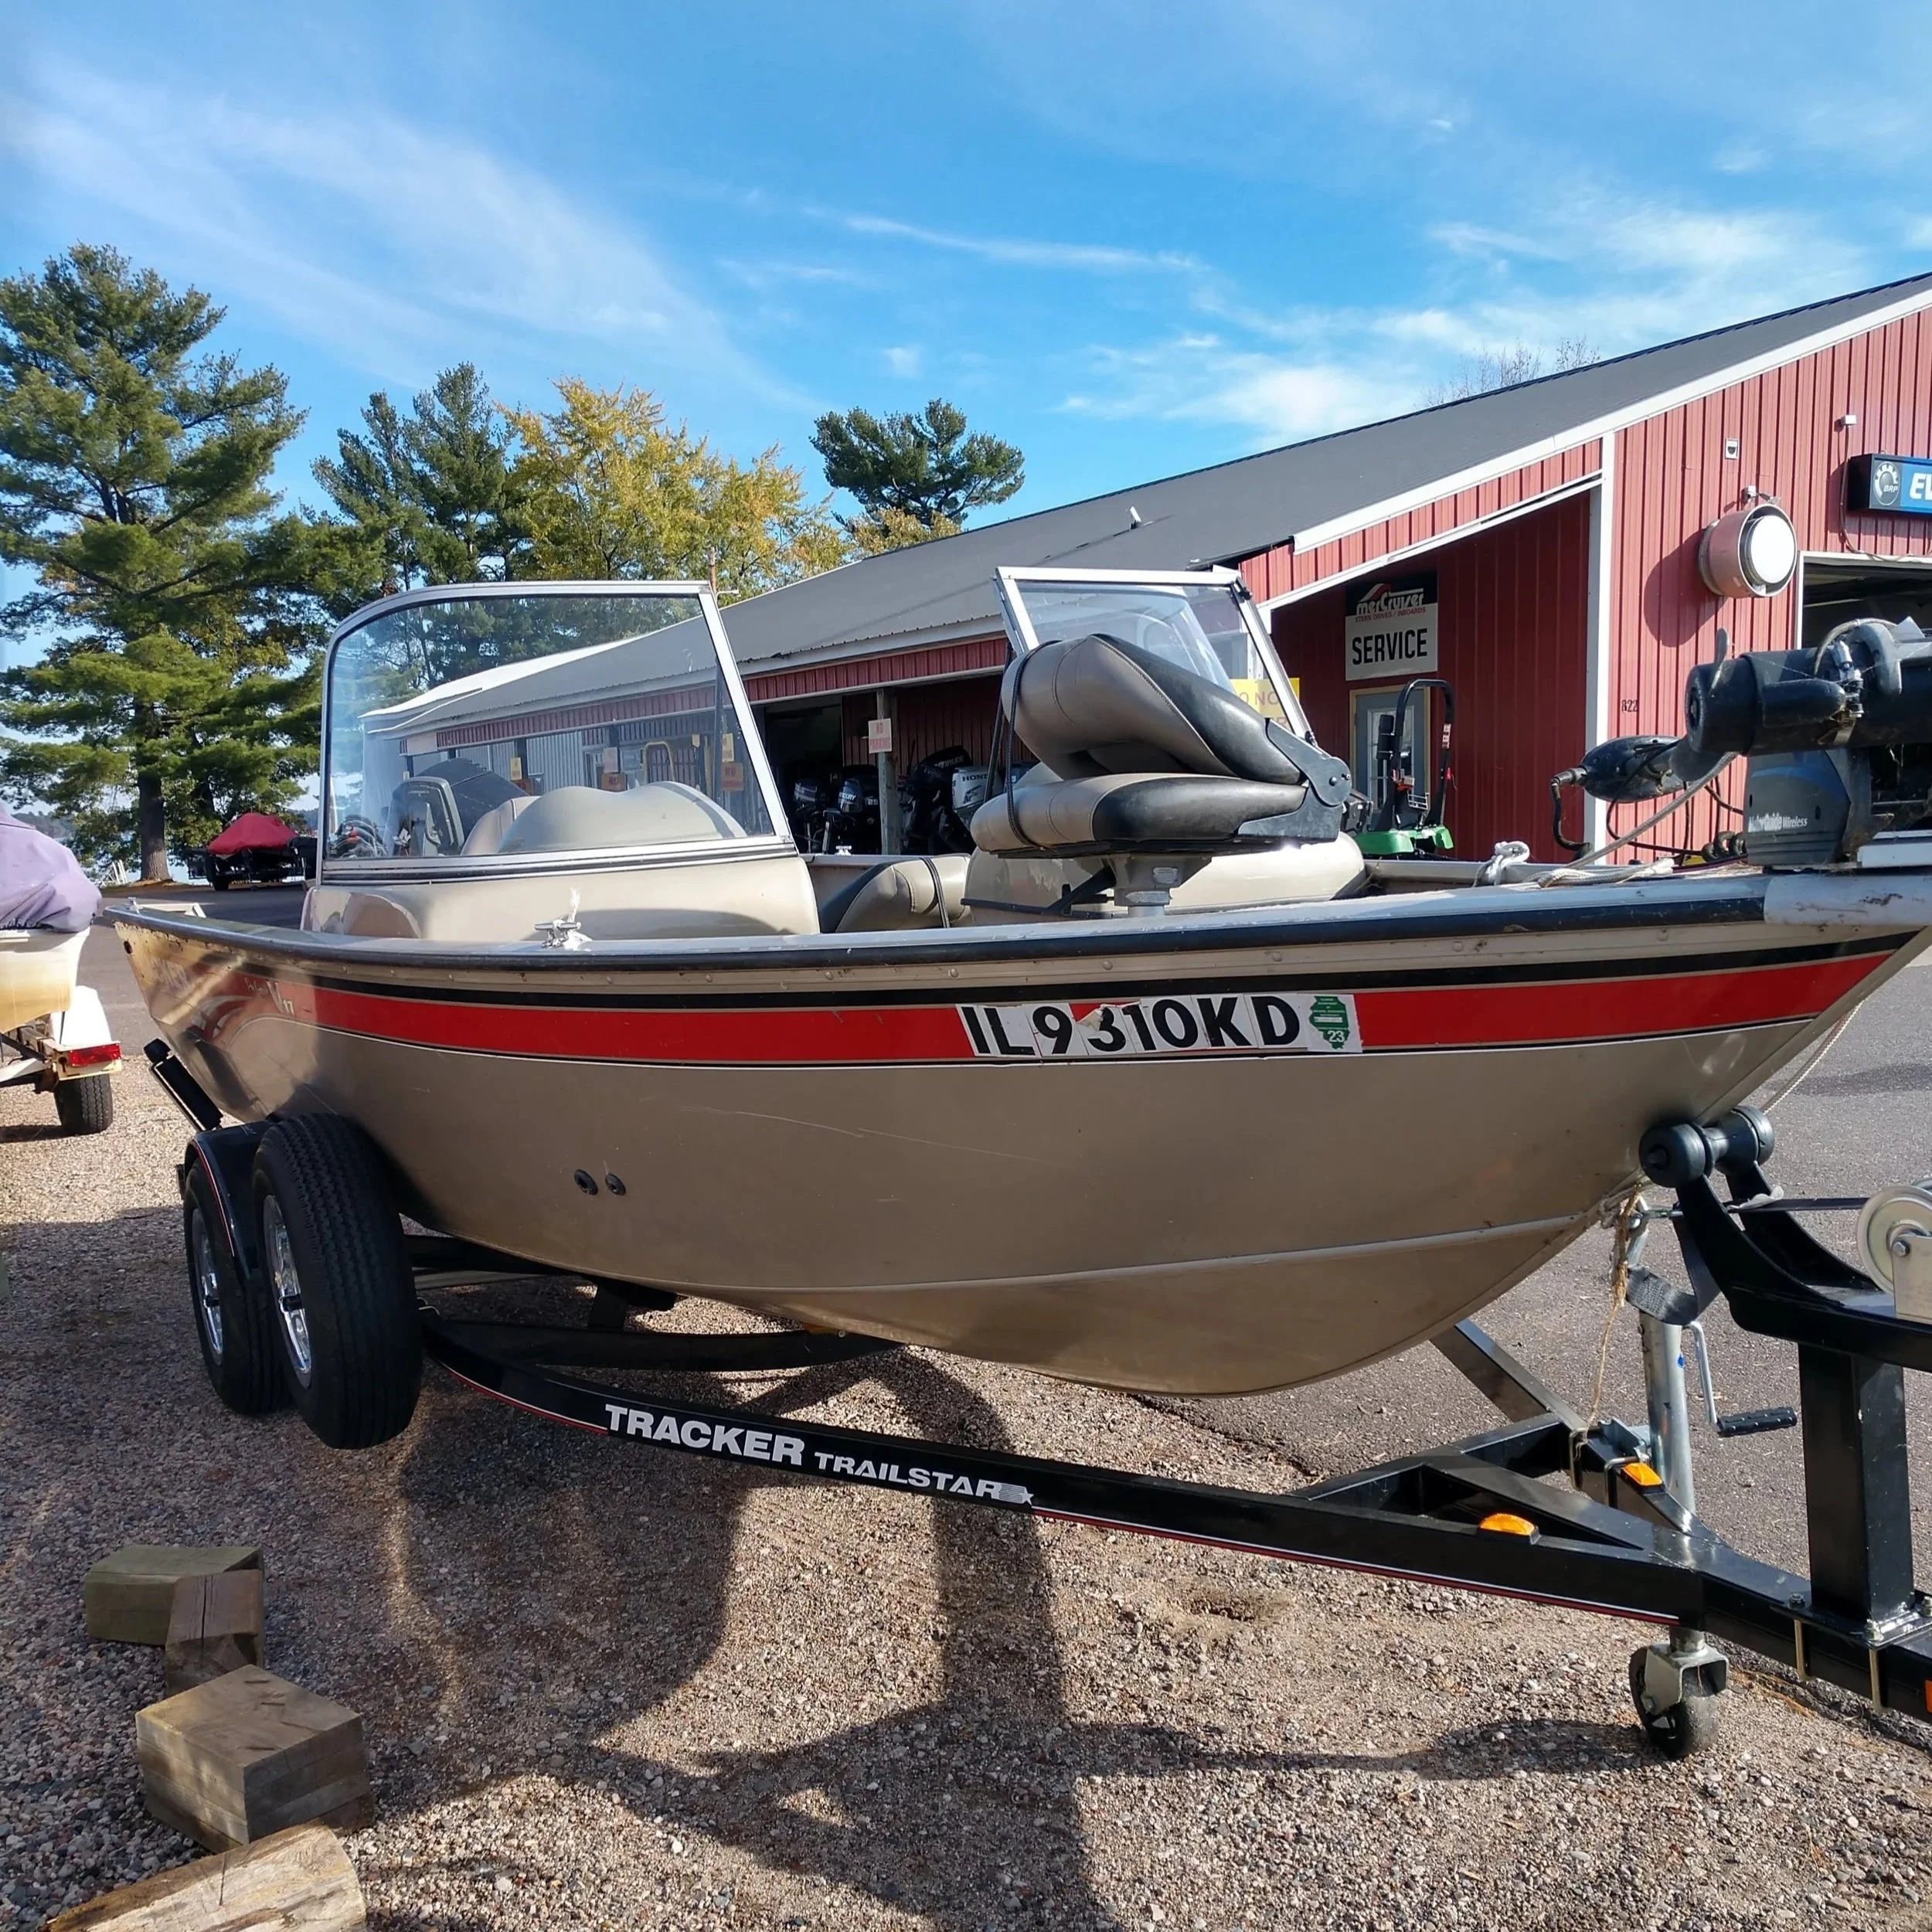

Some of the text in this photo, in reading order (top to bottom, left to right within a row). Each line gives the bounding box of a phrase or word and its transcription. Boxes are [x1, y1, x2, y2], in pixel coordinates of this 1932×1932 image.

[1883, 485, 1899, 493] BRP
[1373, 611, 1392, 621] DRIVES
[1397, 606, 1427, 617] INBOARDS
[1352, 628, 1427, 665] SERVICE
[1254, 691, 1280, 706] NO
[961, 774, 988, 782] HOND
[1782, 815, 1808, 829] Wireless
[1327, 1029, 1345, 1043] 23
[605, 1403, 1002, 1502] TRACKER TRAILSTAR
